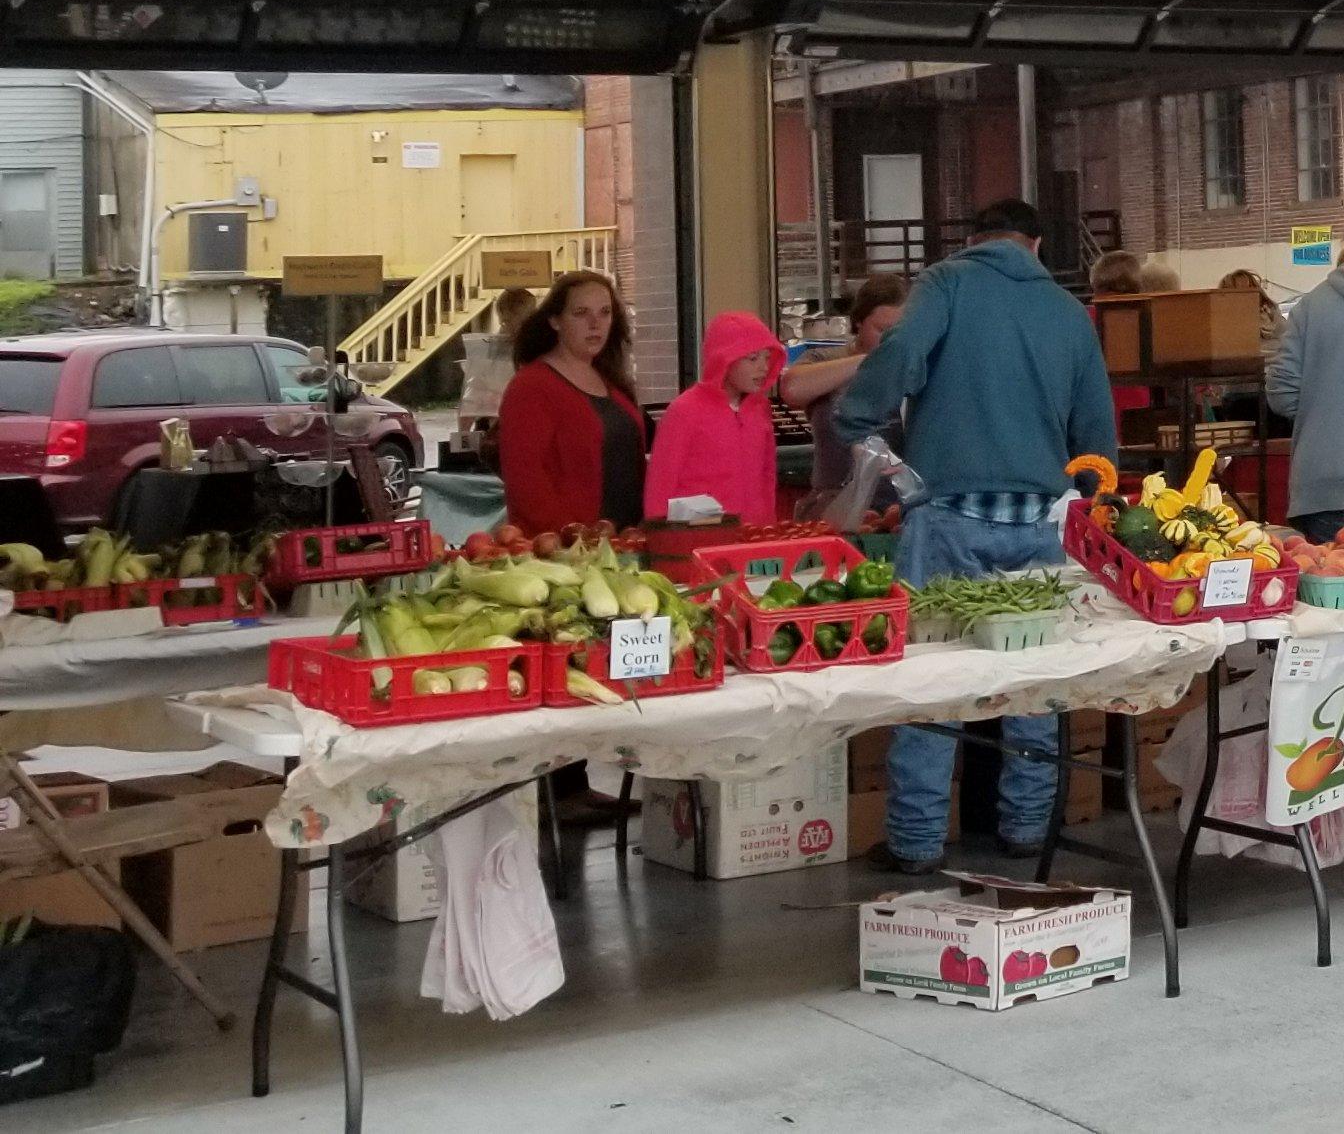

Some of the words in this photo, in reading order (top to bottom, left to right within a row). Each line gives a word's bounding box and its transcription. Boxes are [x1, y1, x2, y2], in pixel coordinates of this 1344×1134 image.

[620, 633, 663, 647] Sweet
[622, 652, 659, 666] Corn
[1004, 923, 1035, 939] FARM
[1035, 914, 1072, 931] FRESH
[1074, 903, 1127, 923] PRODUCE
[864, 920, 892, 934] FARM
[893, 924, 922, 938] FRESH
[924, 929, 970, 944] PRODUCE
